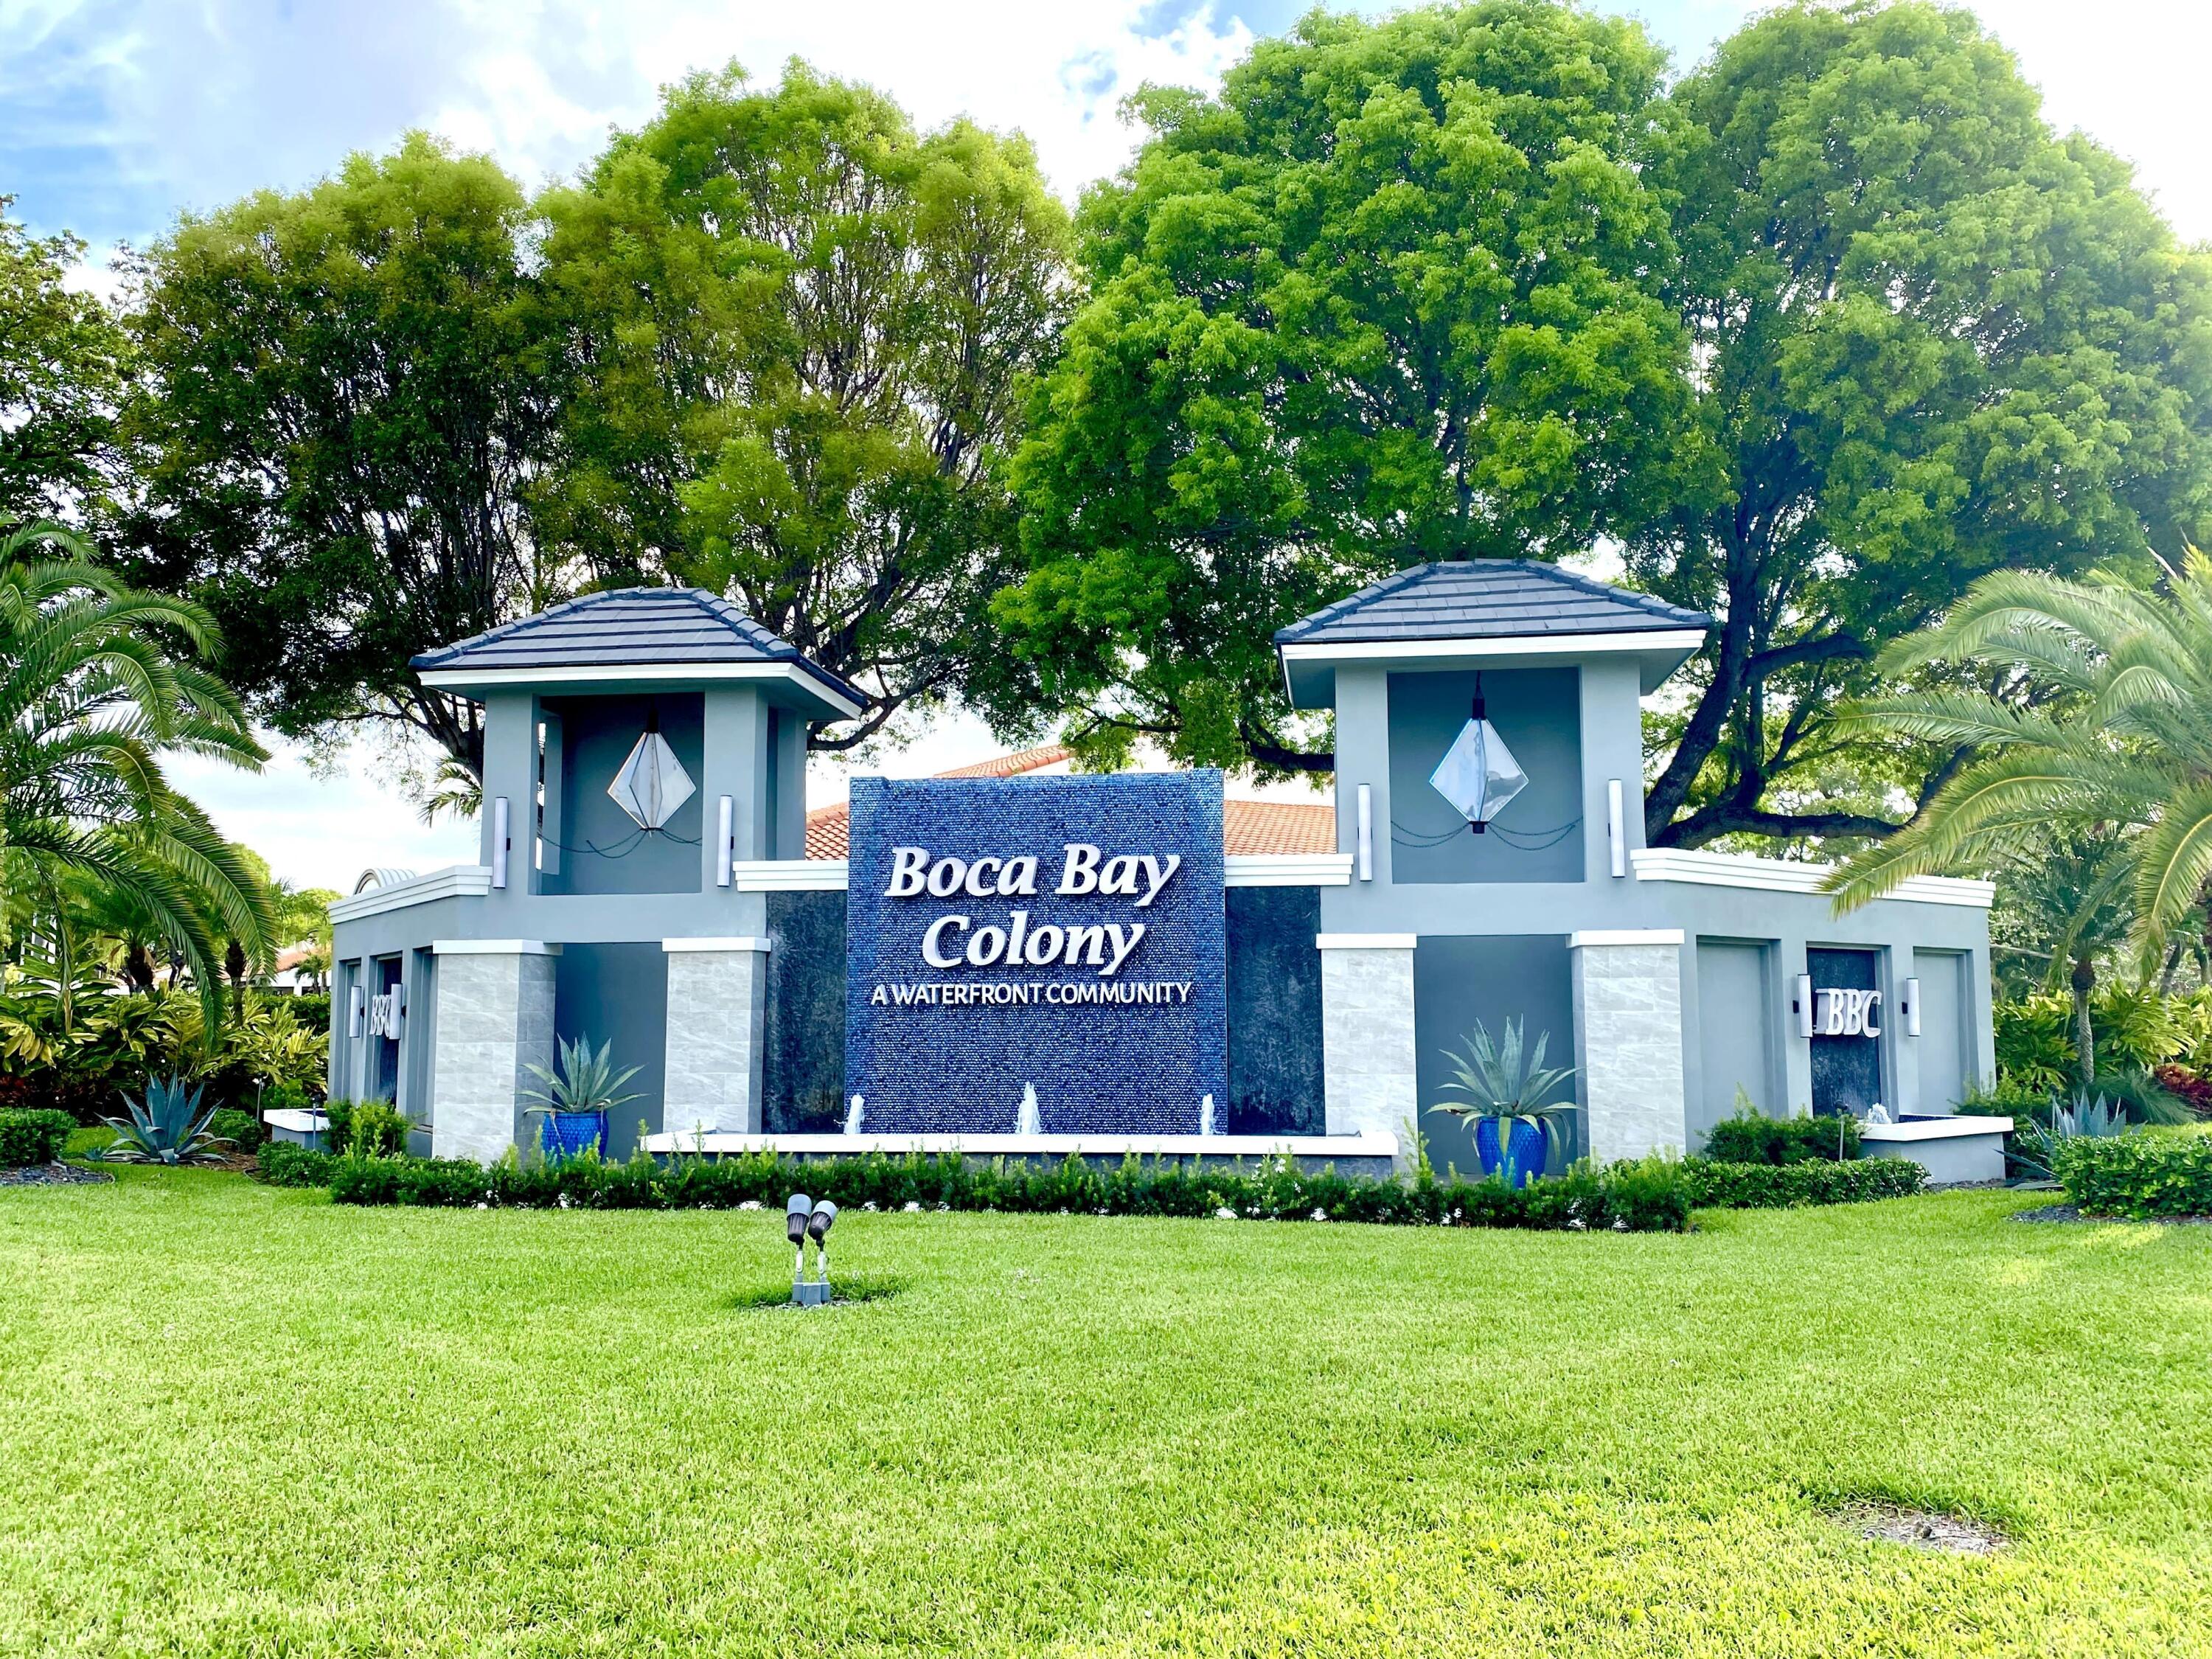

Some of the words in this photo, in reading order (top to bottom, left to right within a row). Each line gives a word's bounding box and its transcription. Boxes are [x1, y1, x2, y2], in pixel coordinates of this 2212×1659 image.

[884, 846, 1037, 897] Boca
[1055, 844, 1181, 907] Bay
[922, 910, 1147, 975] Colony
[870, 984, 890, 1005] A
[892, 983, 1043, 1005] WATERFRONT
[1046, 981, 1192, 1005] COMMUNITY
[1825, 988, 1882, 1037] BBC
